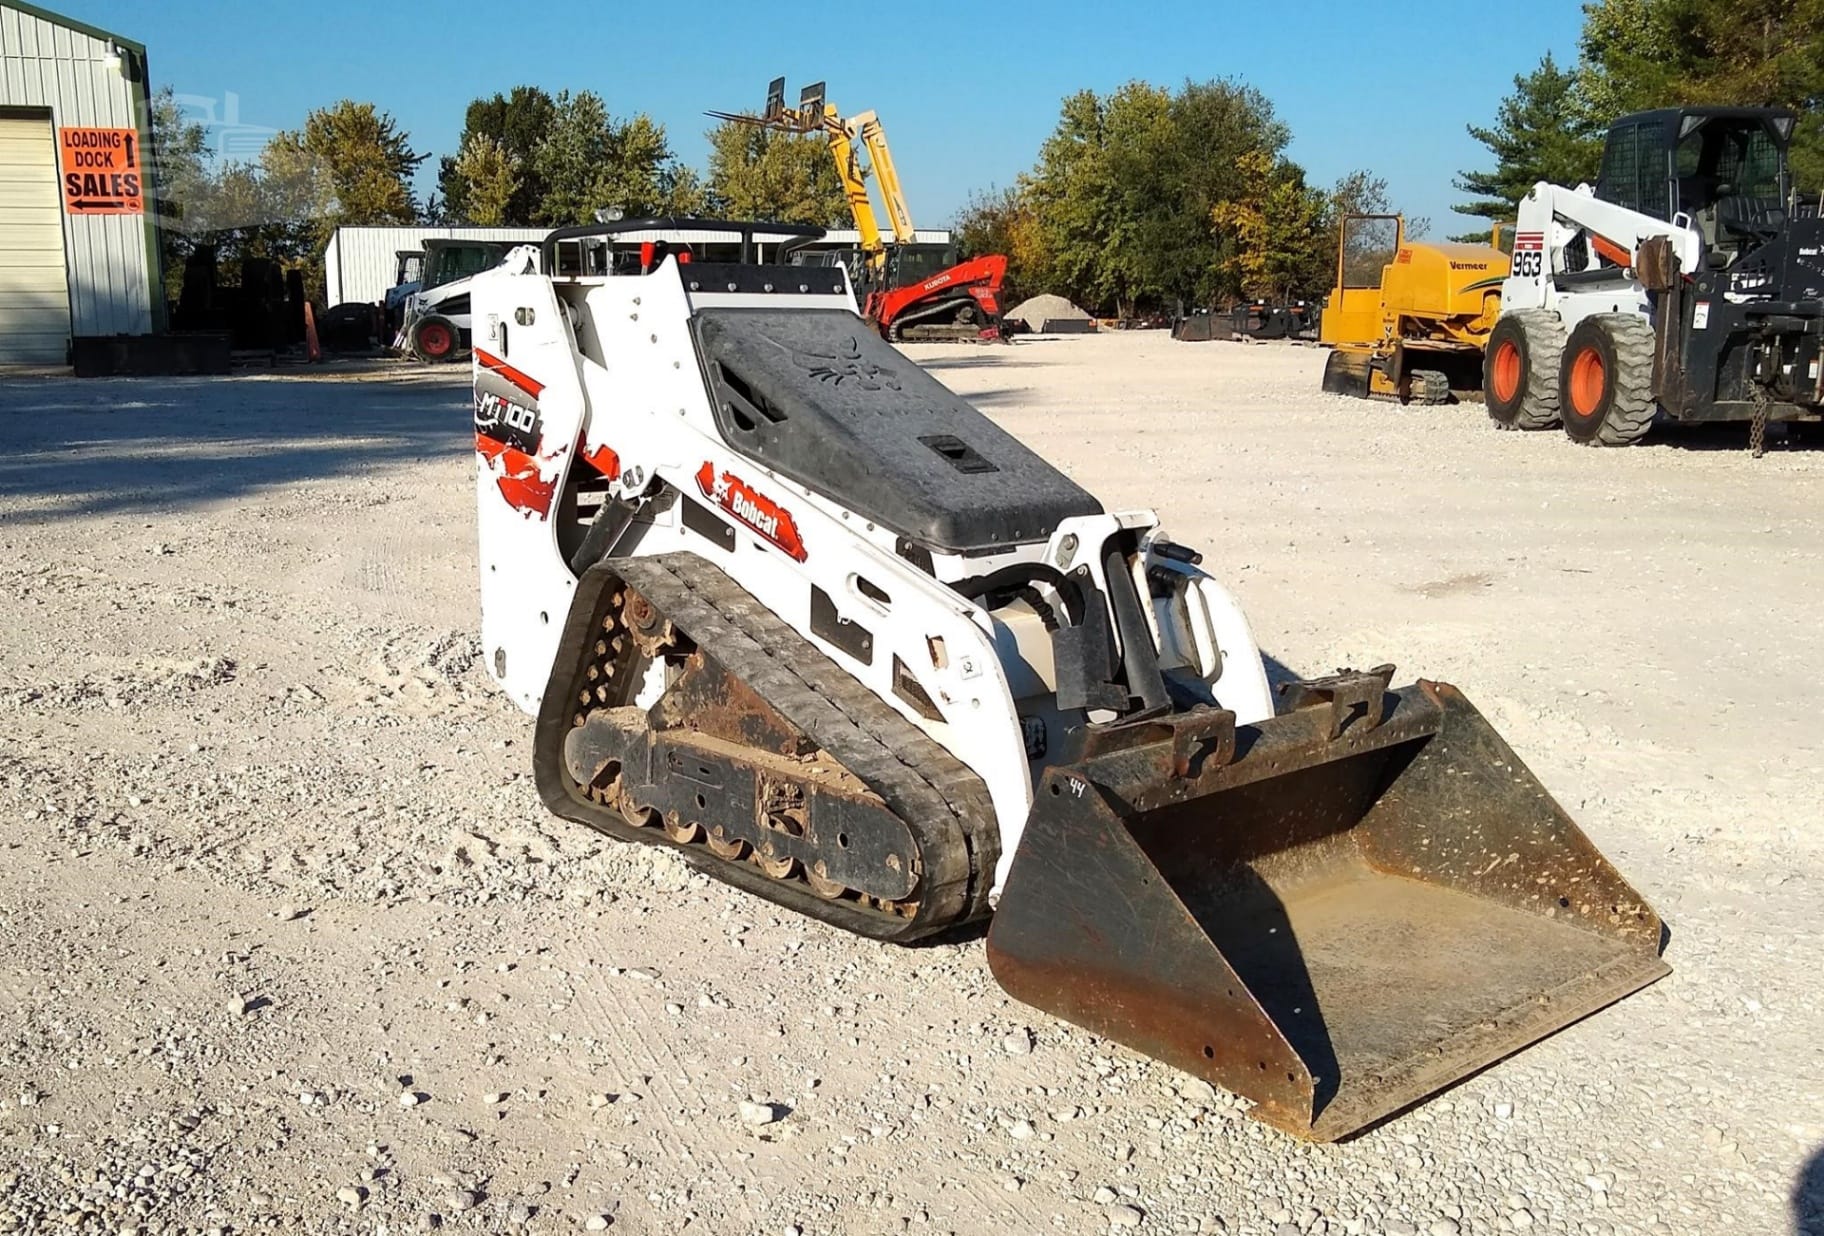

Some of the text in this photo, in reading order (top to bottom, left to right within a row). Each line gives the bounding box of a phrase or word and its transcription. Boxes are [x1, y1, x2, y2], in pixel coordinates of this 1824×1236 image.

[64, 131, 121, 149] LOADING
[74, 150, 114, 168] DOCK
[66, 172, 140, 197] SALES
[1450, 261, 1488, 271] Vermeer
[1513, 251, 1542, 278] 963
[923, 274, 952, 292] KUBOTA
[731, 489, 779, 541] Bobcat
